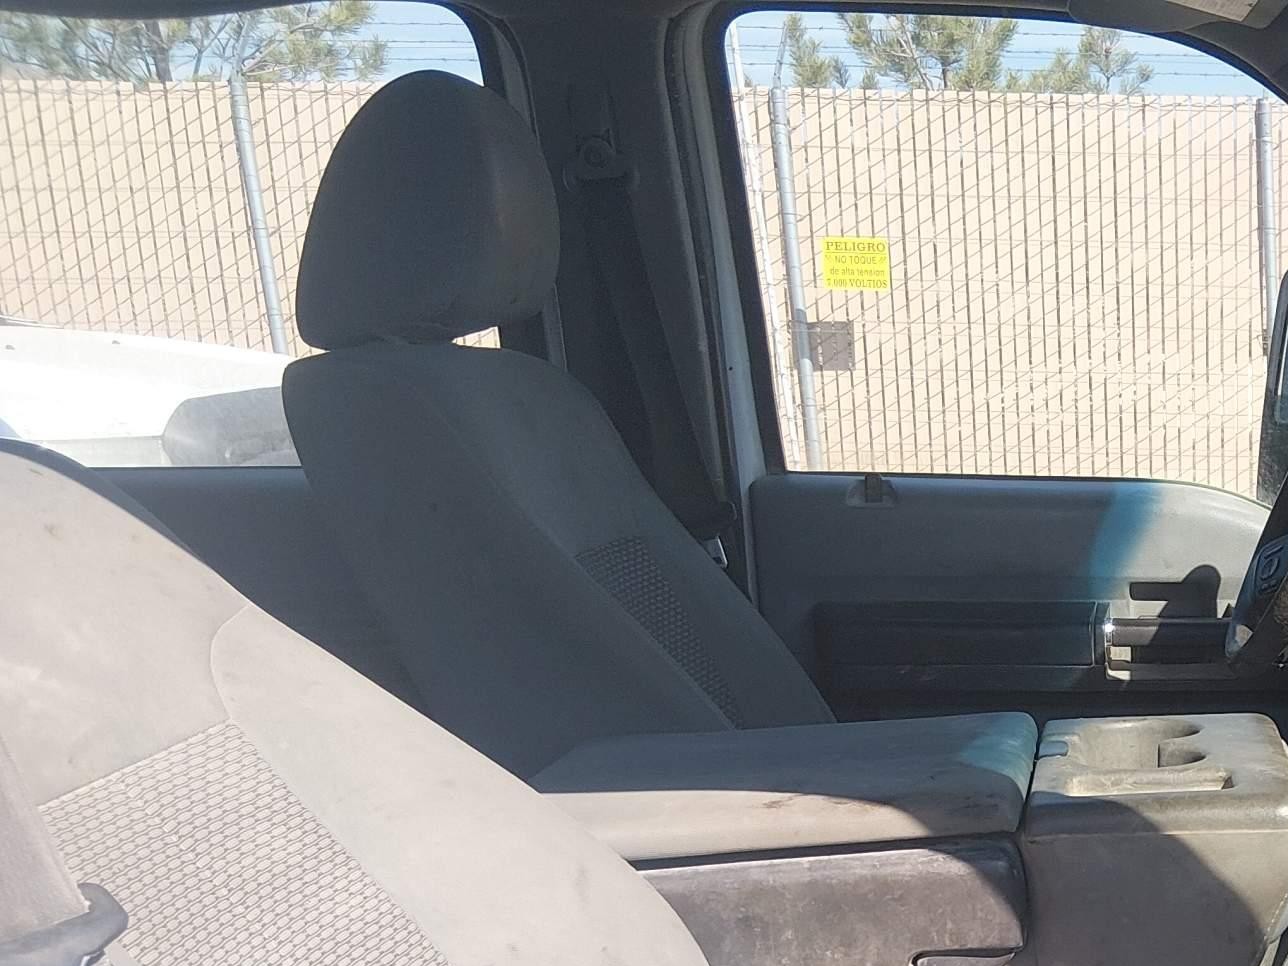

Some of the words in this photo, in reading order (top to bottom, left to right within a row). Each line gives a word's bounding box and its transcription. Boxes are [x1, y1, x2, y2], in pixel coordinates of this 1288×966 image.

[825, 241, 886, 252] PELIGRO
[834, 255, 847, 264] NO
[849, 255, 877, 265] TOQUE
[829, 266, 840, 275] de
[841, 266, 855, 276] alta
[849, 279, 888, 289] VOLTIOS
